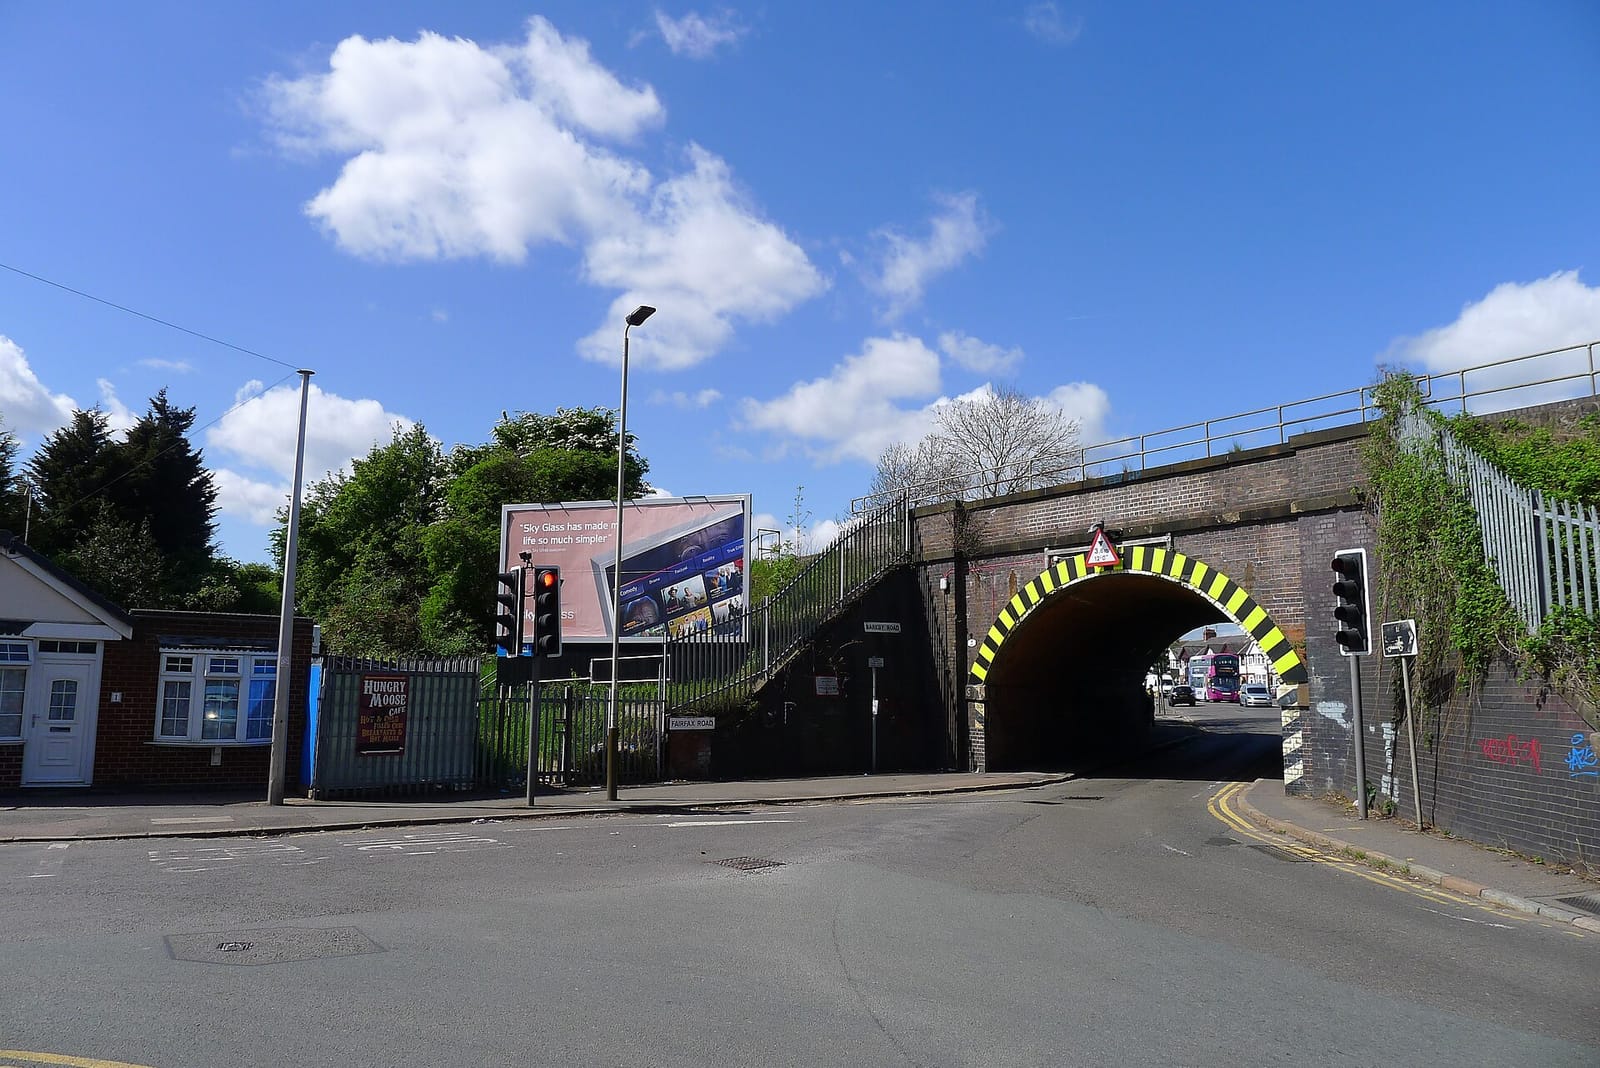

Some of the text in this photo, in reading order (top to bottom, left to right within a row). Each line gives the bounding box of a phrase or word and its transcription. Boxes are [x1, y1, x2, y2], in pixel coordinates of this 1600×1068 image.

[542, 522, 565, 532] Glass
[567, 521, 583, 531] has
[584, 520, 609, 531] made
[523, 535, 537, 545] life
[538, 536, 549, 545] so
[550, 534, 568, 545] much
[619, 585, 639, 597] Comedy
[886, 623, 900, 631] ROAD
[364, 680, 406, 694] HUNGRY
[369, 694, 407, 707] MOOSE
[671, 719, 714, 728] FAIRFAX ROAD
